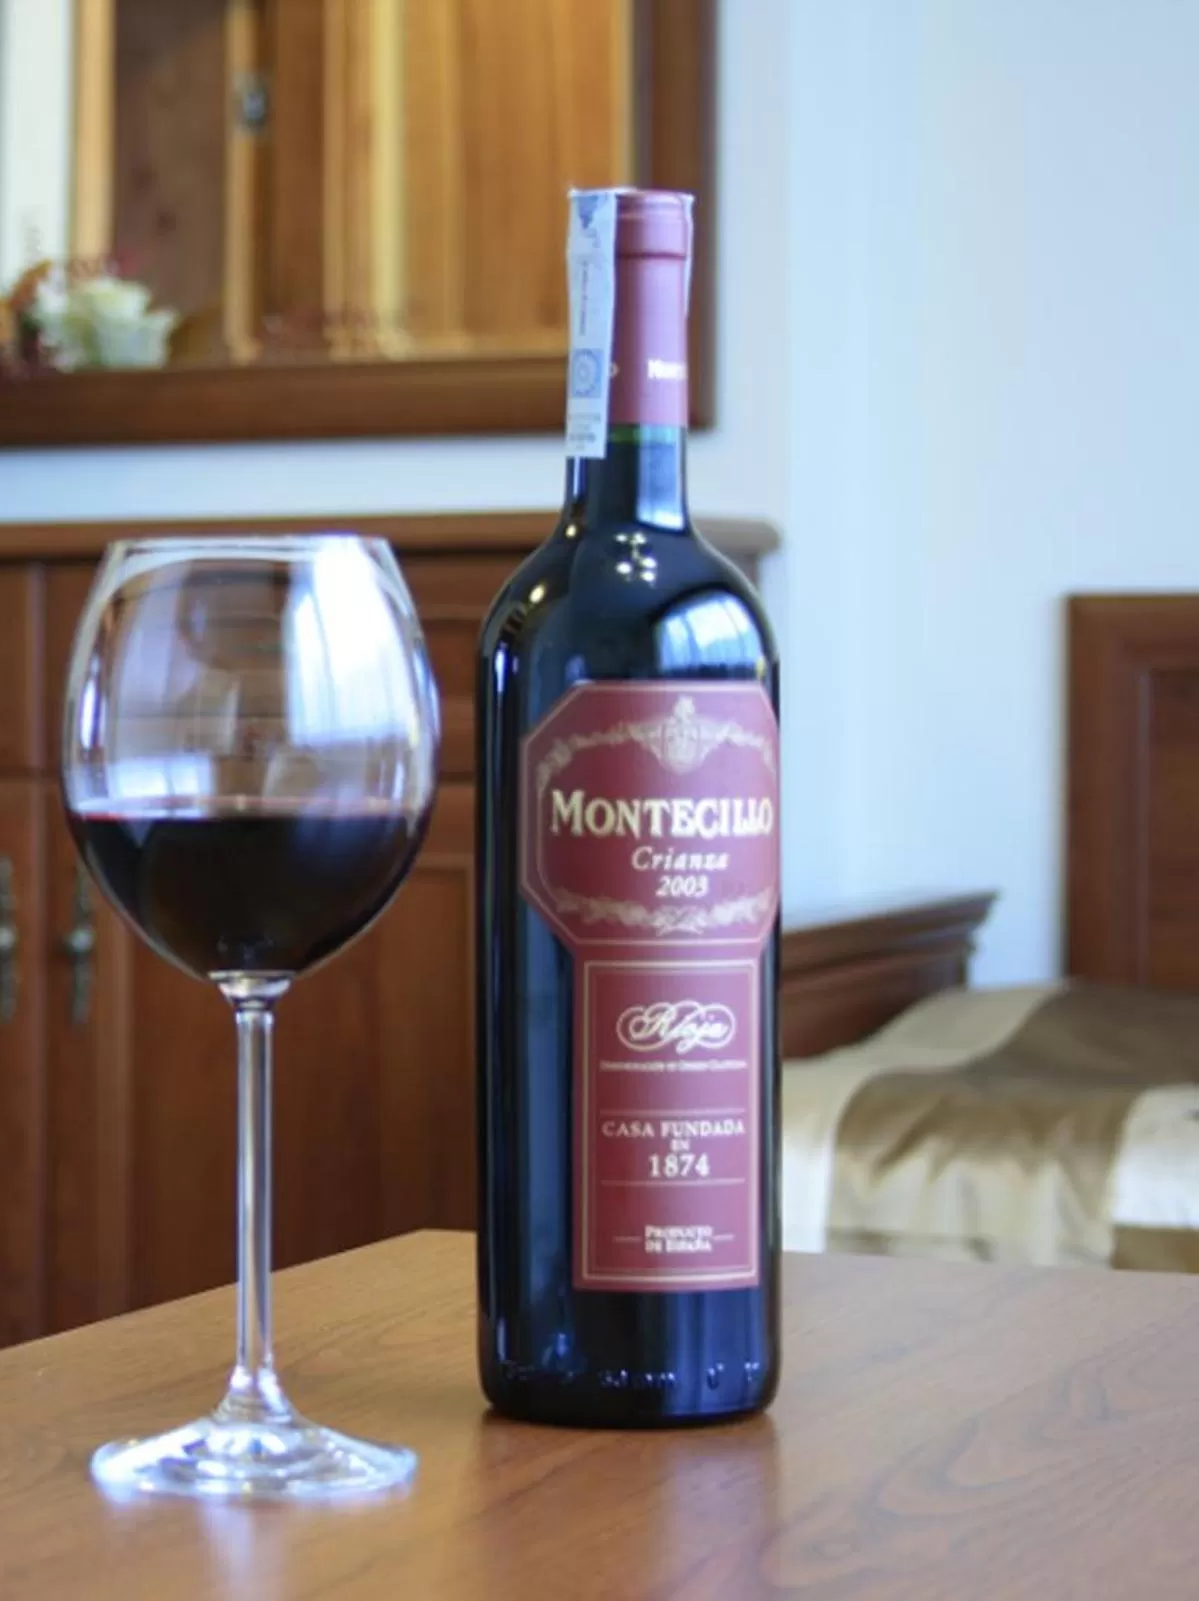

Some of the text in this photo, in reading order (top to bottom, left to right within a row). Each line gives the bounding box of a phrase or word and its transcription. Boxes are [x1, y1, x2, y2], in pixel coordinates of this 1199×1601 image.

[551, 789, 774, 839] MONTECILLO
[631, 846, 730, 871] Crianza
[655, 875, 709, 898] 2003
[601, 1118, 746, 1138] CASA FUNDADA
[670, 1139, 691, 1152] EN
[649, 1152, 710, 1178] 1874
